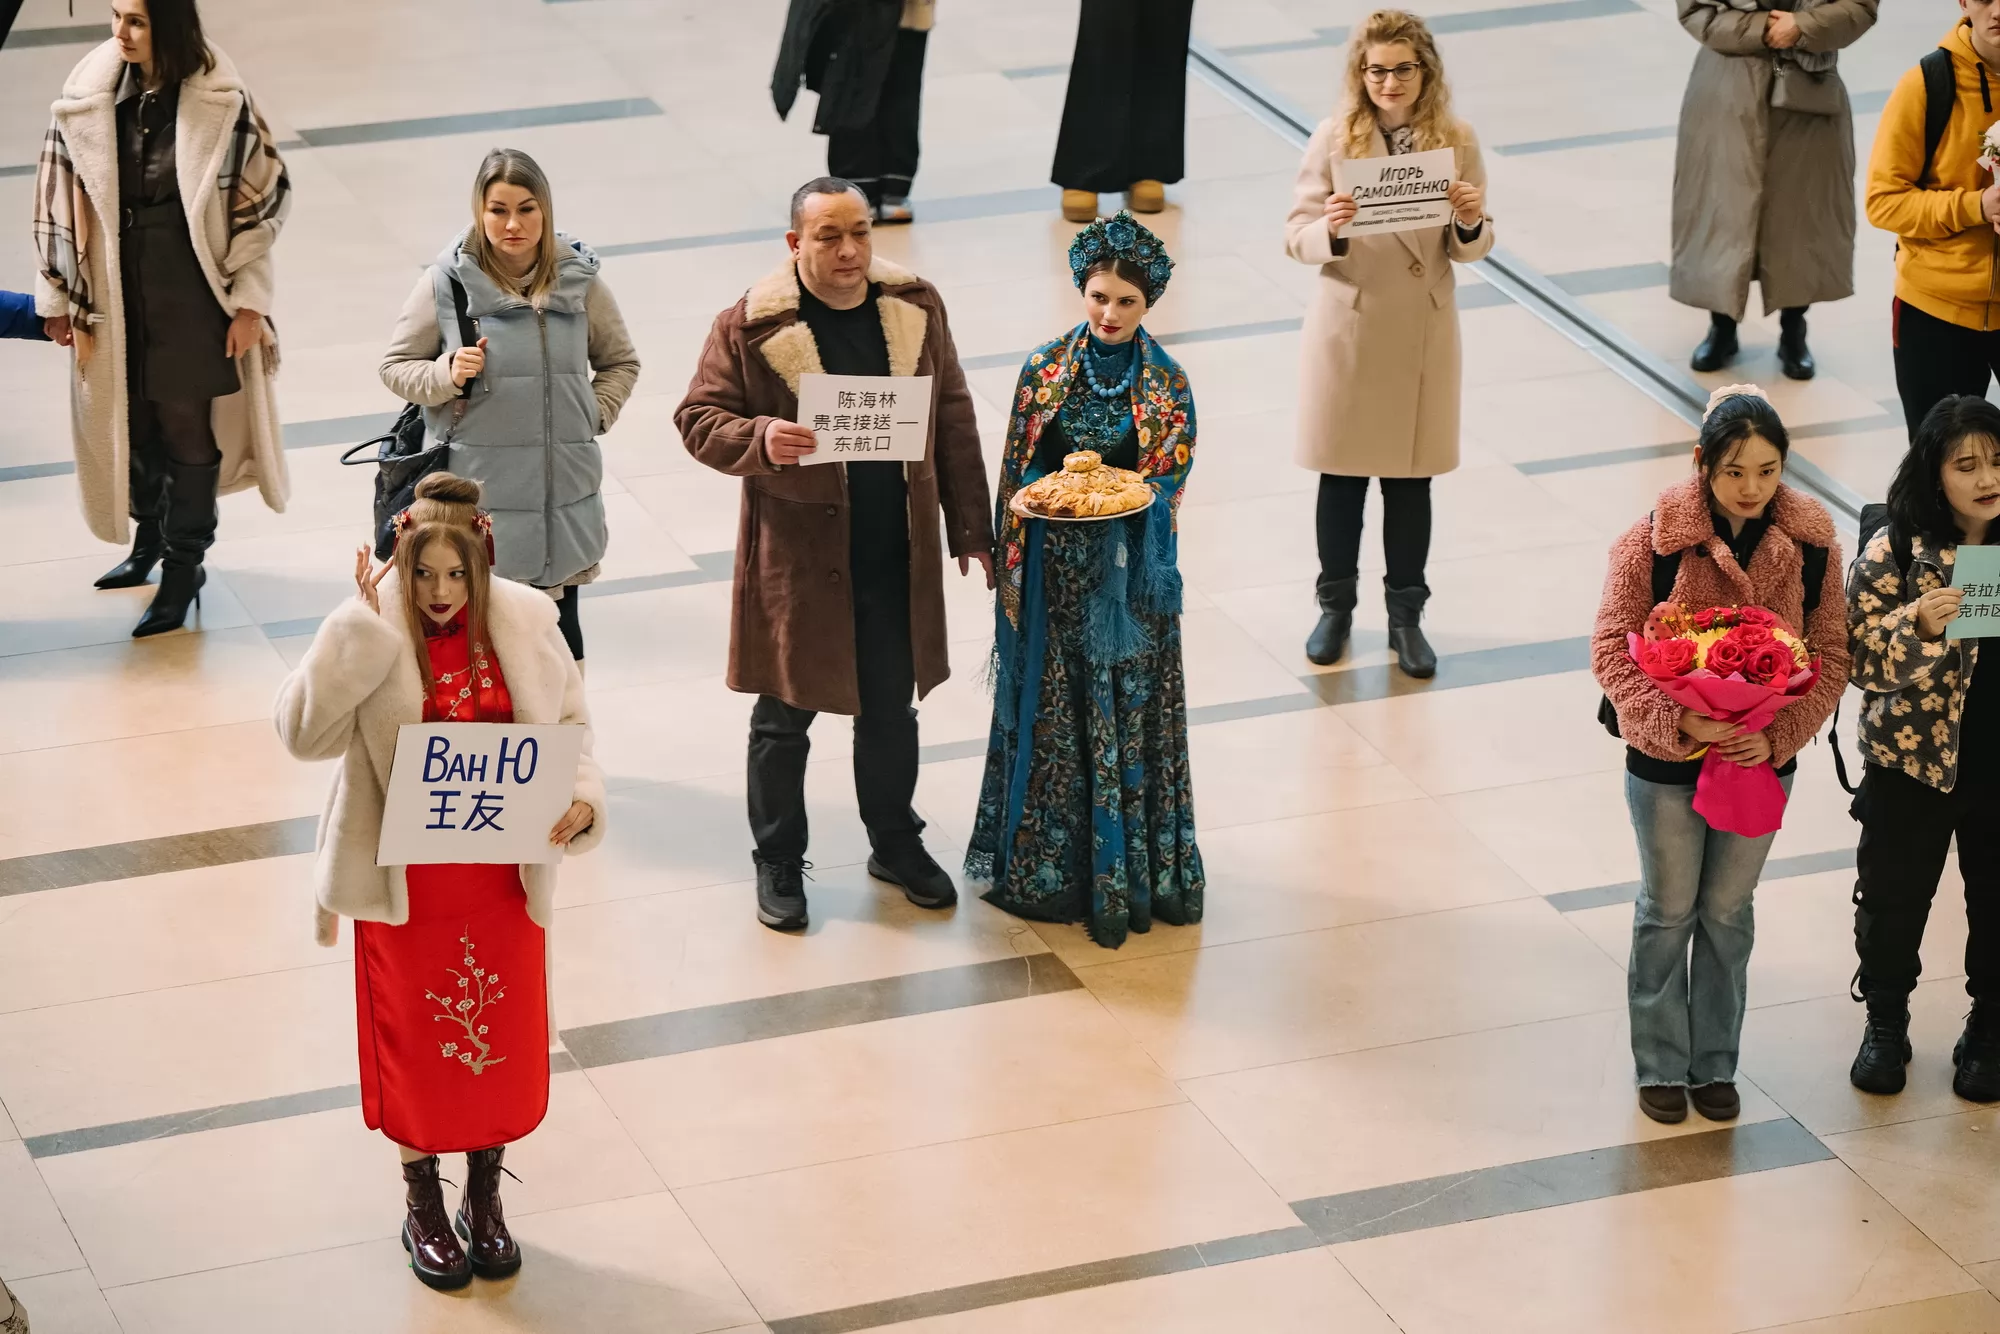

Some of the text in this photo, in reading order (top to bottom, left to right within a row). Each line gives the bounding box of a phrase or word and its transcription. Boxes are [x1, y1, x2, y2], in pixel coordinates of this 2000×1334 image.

[838, 391, 897, 409] 陈海林
[833, 436, 891, 452] 东航口
[495, 737, 538, 784] Ю
[425, 790, 504, 831] 王友
